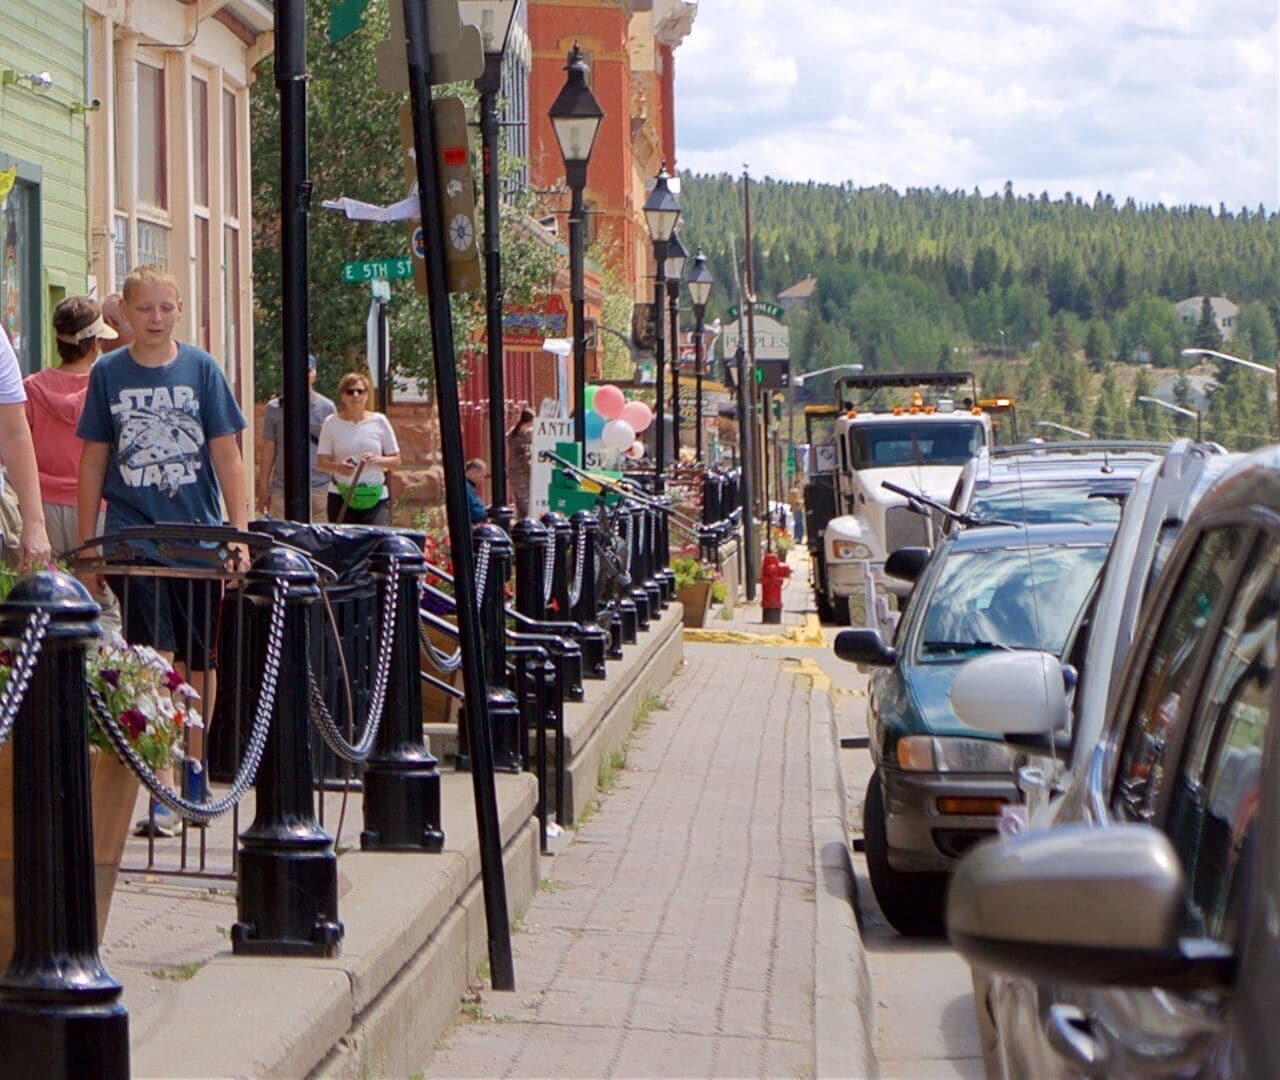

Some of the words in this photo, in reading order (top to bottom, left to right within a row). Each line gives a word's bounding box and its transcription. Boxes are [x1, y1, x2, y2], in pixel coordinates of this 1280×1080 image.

[345, 265, 354, 279] E
[363, 262, 388, 278] 5TH
[397, 260, 413, 275] ST
[110, 386, 200, 416] STAR
[120, 461, 202, 491] WARS
